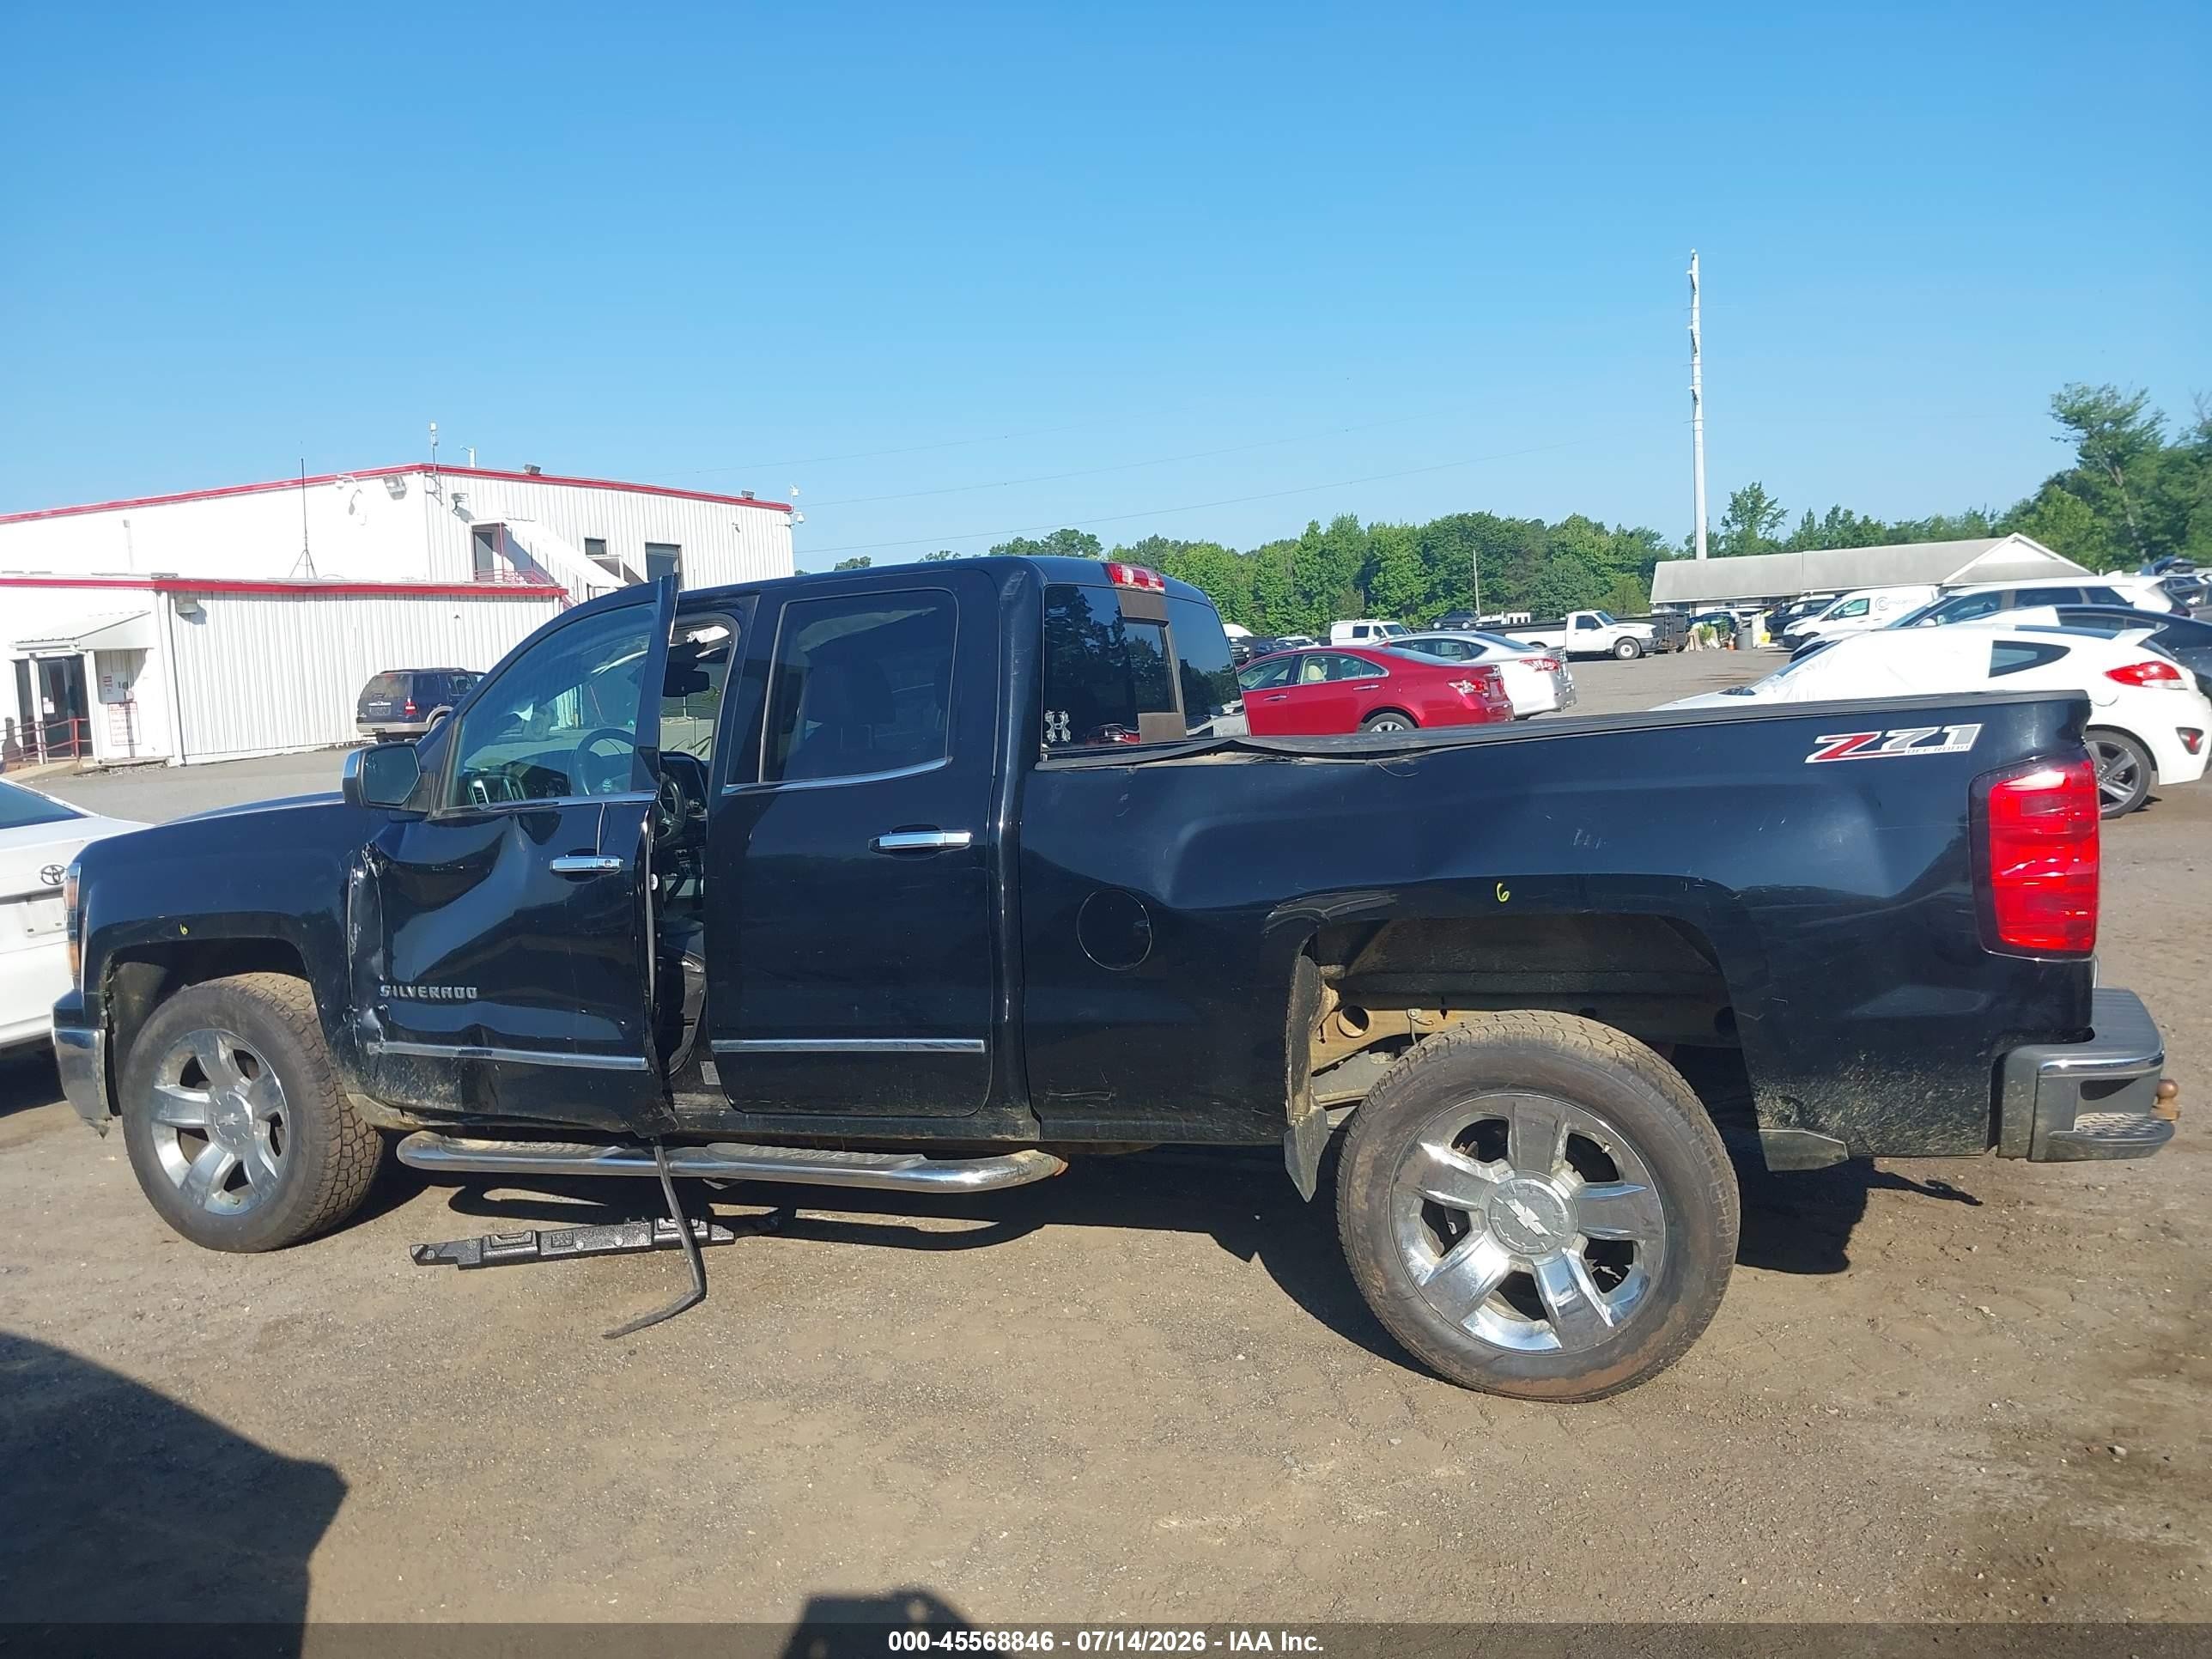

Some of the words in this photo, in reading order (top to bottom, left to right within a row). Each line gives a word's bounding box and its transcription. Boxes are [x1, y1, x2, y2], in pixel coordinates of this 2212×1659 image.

[1804, 723, 1984, 763] Z71
[1496, 882, 1510, 902] 6
[380, 985, 478, 1000] SILVERADO
